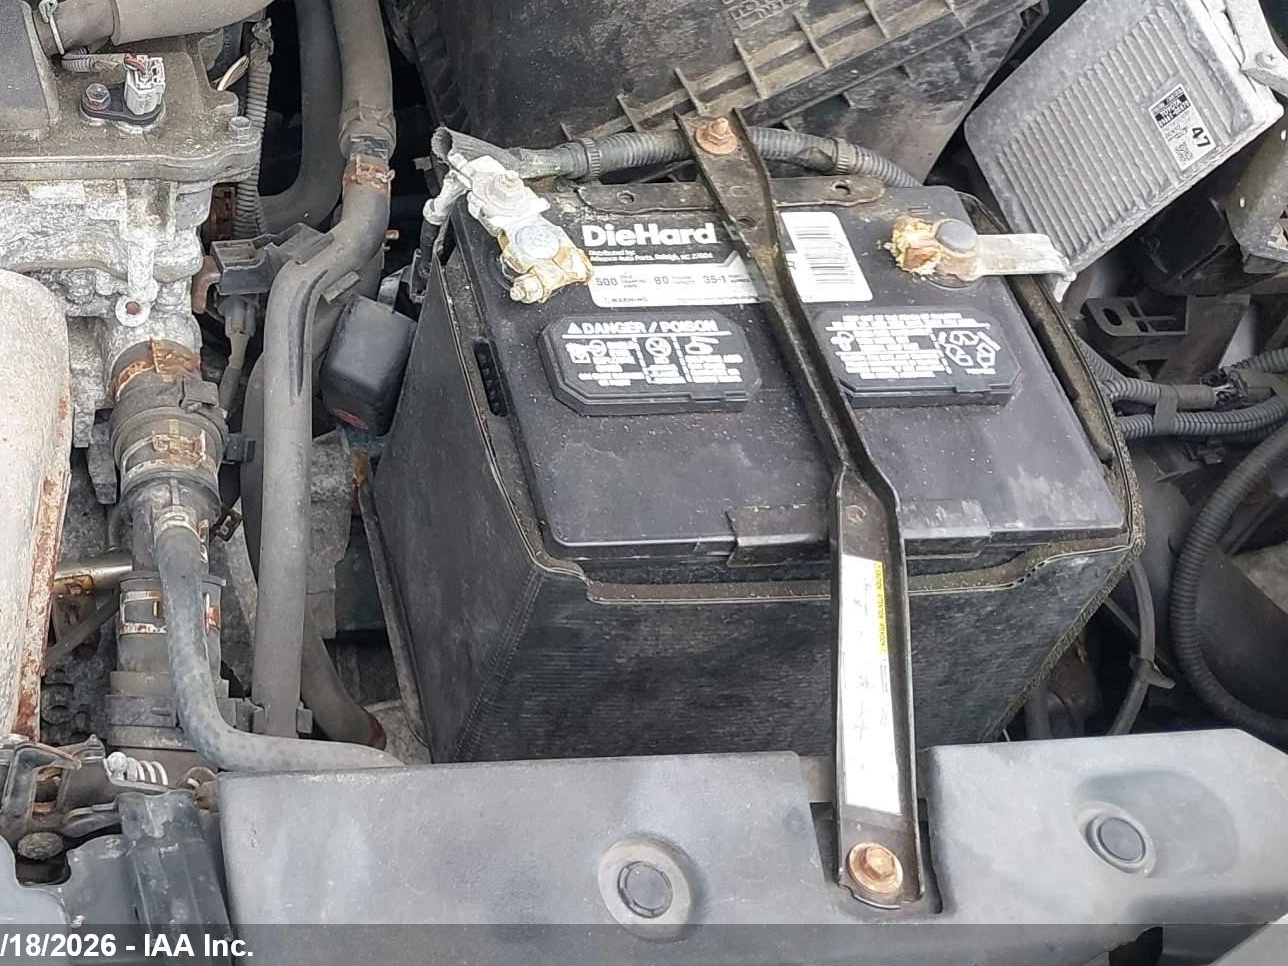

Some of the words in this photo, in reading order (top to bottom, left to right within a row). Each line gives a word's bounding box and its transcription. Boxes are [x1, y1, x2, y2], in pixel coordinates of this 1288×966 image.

[1161, 98, 1182, 117] TOYOTA
[1192, 127, 1211, 147] 47
[581, 222, 718, 247] DieHard
[595, 277, 618, 287] 500
[702, 275, 727, 284] 35-1
[582, 321, 647, 334] DANGER
[659, 320, 719, 333] POISON
